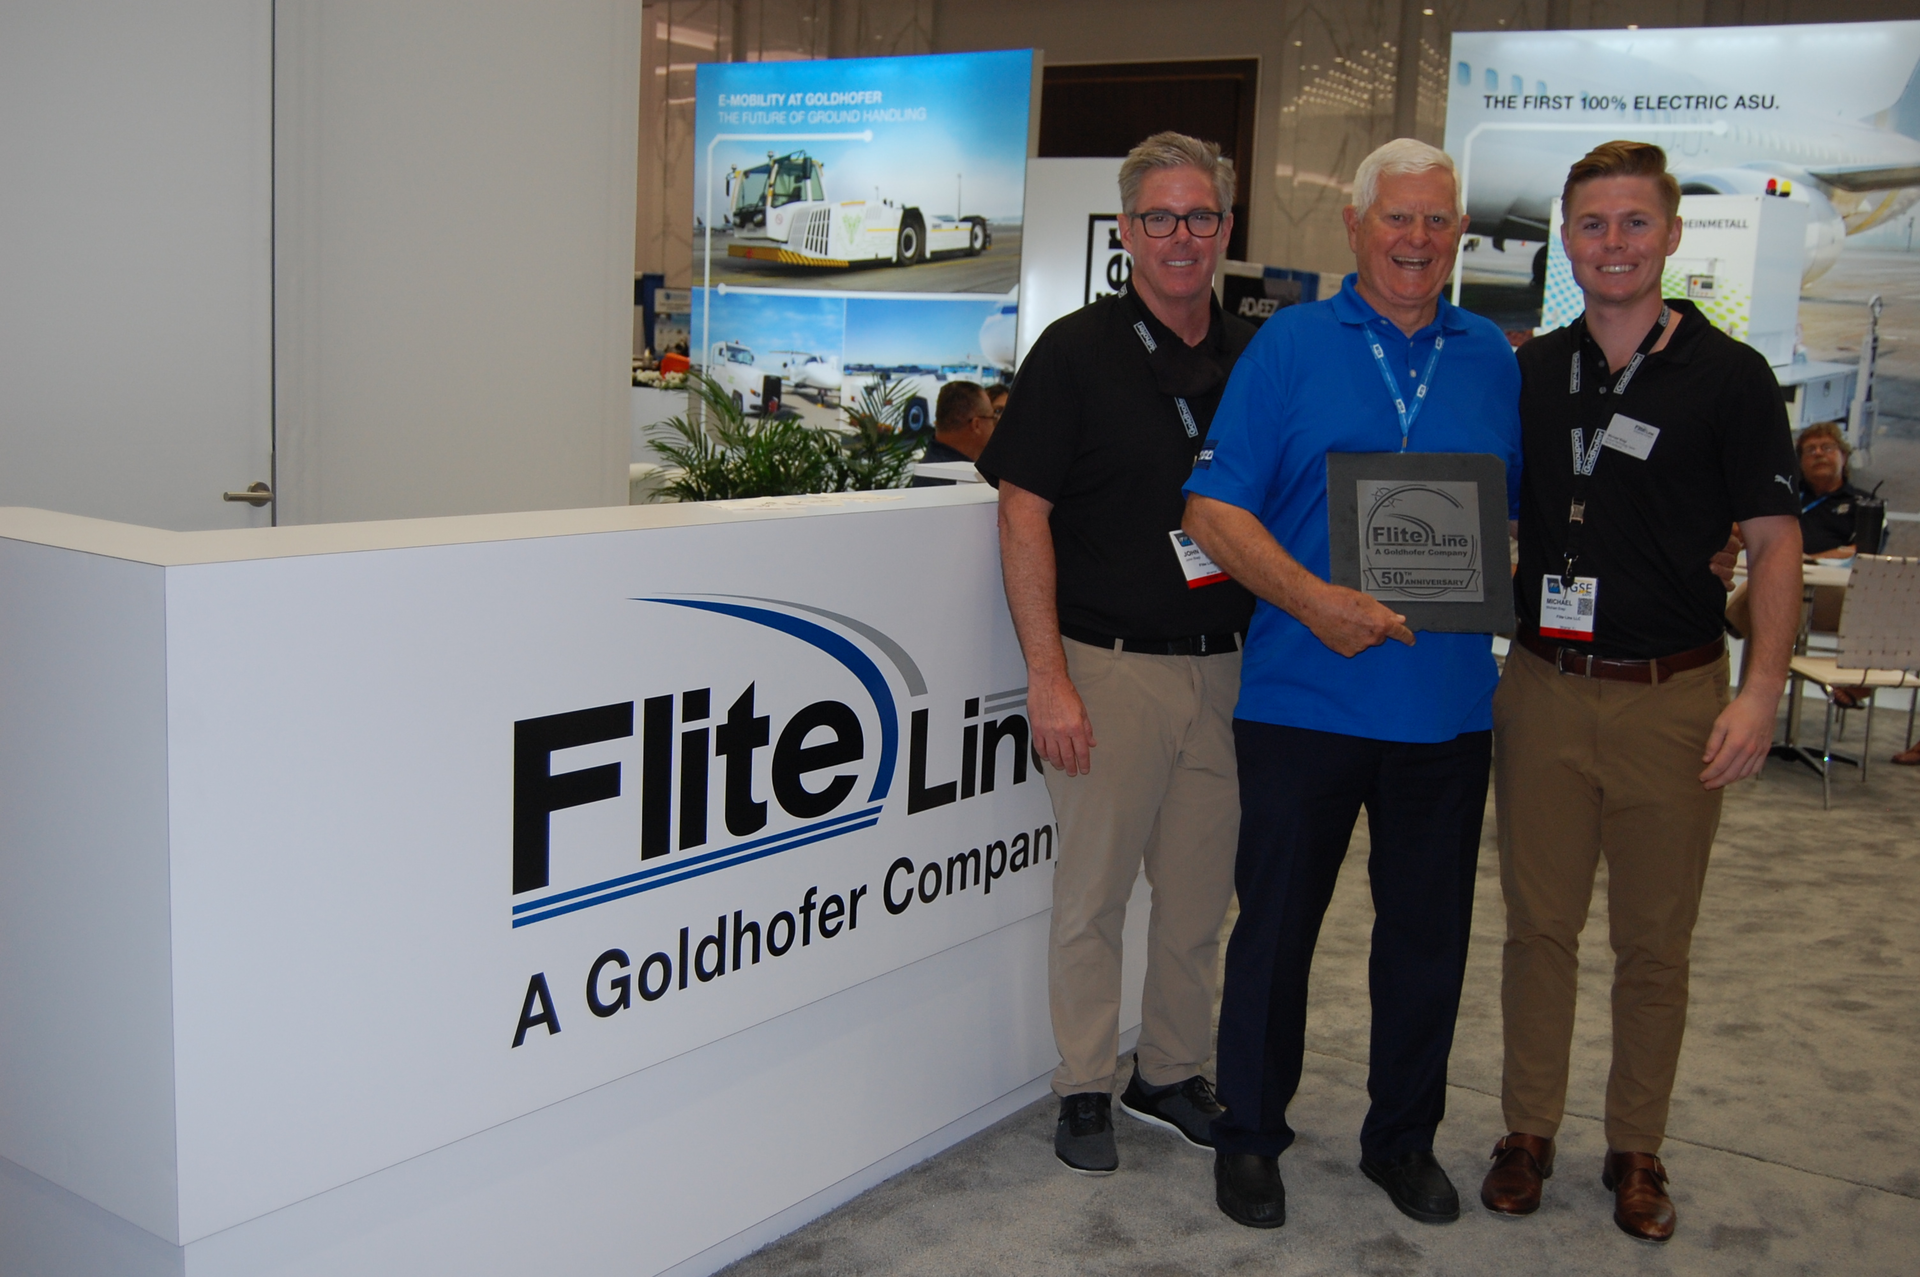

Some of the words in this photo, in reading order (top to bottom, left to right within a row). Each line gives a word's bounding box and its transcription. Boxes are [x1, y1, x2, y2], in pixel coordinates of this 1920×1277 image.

[718, 94, 786, 107] E-MOBILITY
[787, 93, 803, 106] AT
[805, 91, 882, 106] GOLDHOFER
[1484, 95, 1517, 109] THE
[1523, 95, 1574, 109] FIRST
[1581, 95, 1627, 110] 100%
[1634, 95, 1728, 110] ELECTRIC
[1734, 94, 1779, 109] ASU.
[718, 111, 739, 124] THE
[742, 111, 786, 124] FUTURE
[789, 110, 805, 124] OF
[808, 109, 860, 123] GROUND
[862, 107, 927, 122] HANDLING
[1583, 431, 1604, 474] Goldhofer
[1372, 527, 1423, 543] Flite
[1431, 535, 1468, 547] Line
[1428, 549, 1467, 557] Company
[1570, 583, 1592, 593] GSE
[1546, 598, 1572, 606] MICHAEL
[512, 680, 864, 895] Flite
[907, 697, 1044, 816] Lin
[511, 972, 561, 1049] A
[585, 884, 867, 1018] Goldhofer
[883, 822, 1059, 914] Compan
